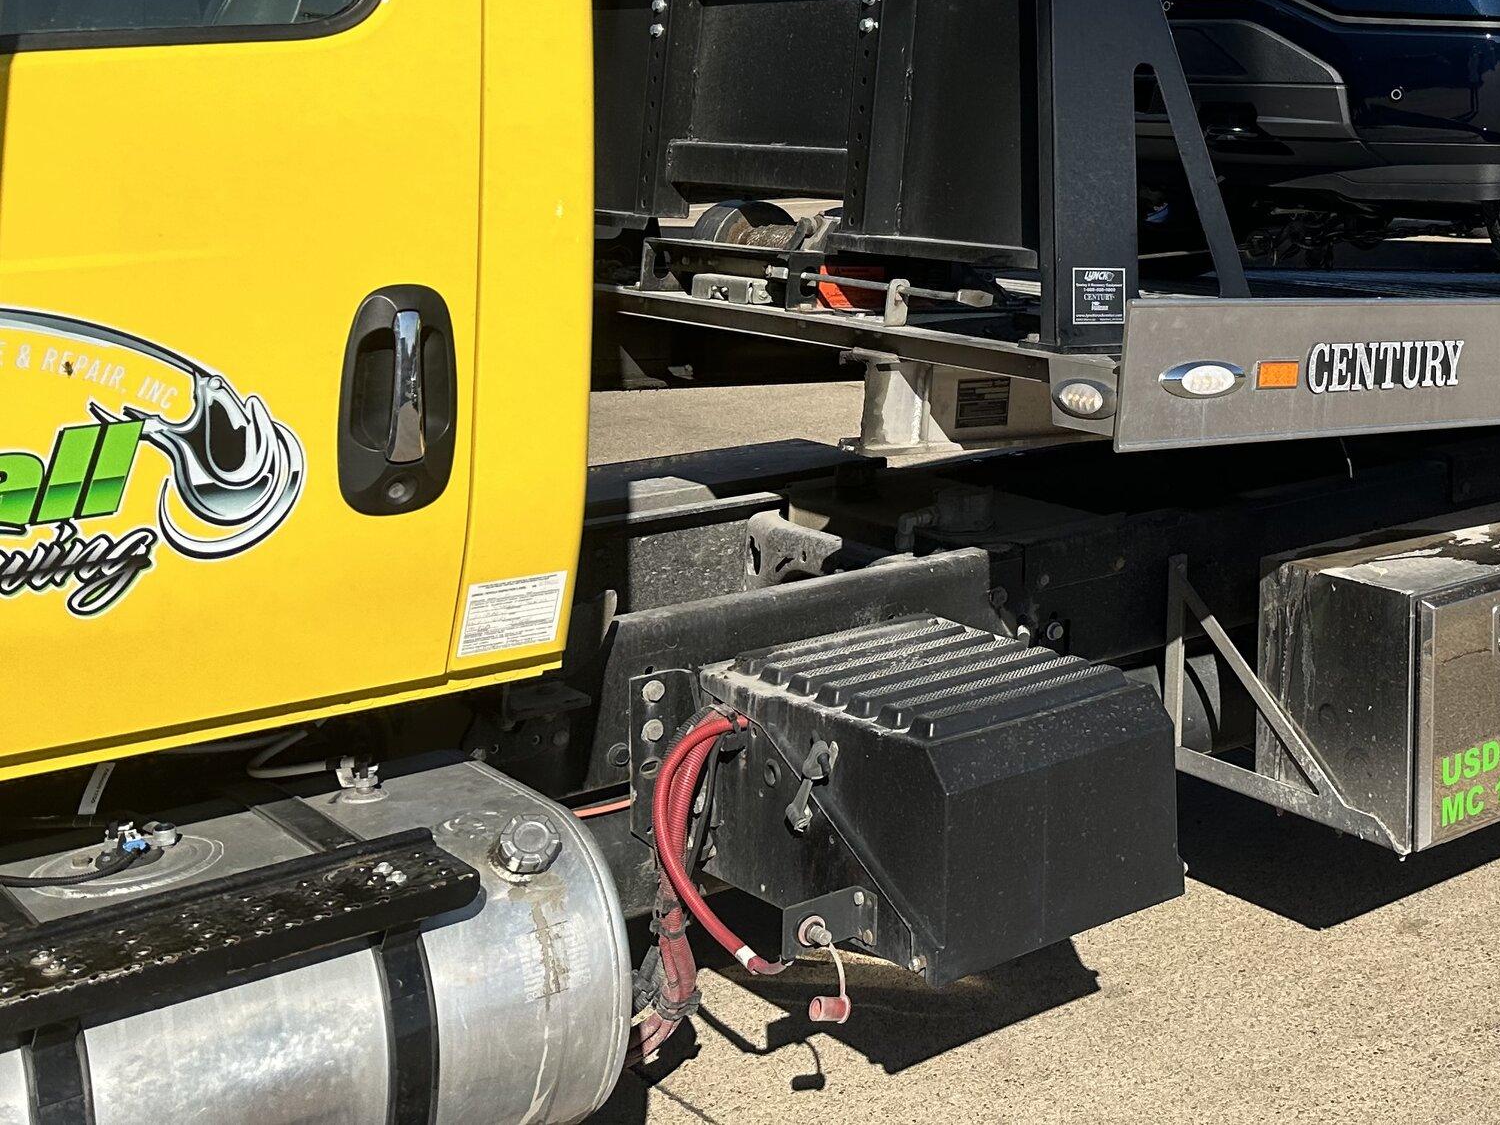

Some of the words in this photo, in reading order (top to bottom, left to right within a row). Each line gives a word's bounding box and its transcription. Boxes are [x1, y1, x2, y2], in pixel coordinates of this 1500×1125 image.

[16, 344, 31, 369] &
[1308, 340, 1465, 394] CENTURY
[1441, 785, 1484, 827] MC
